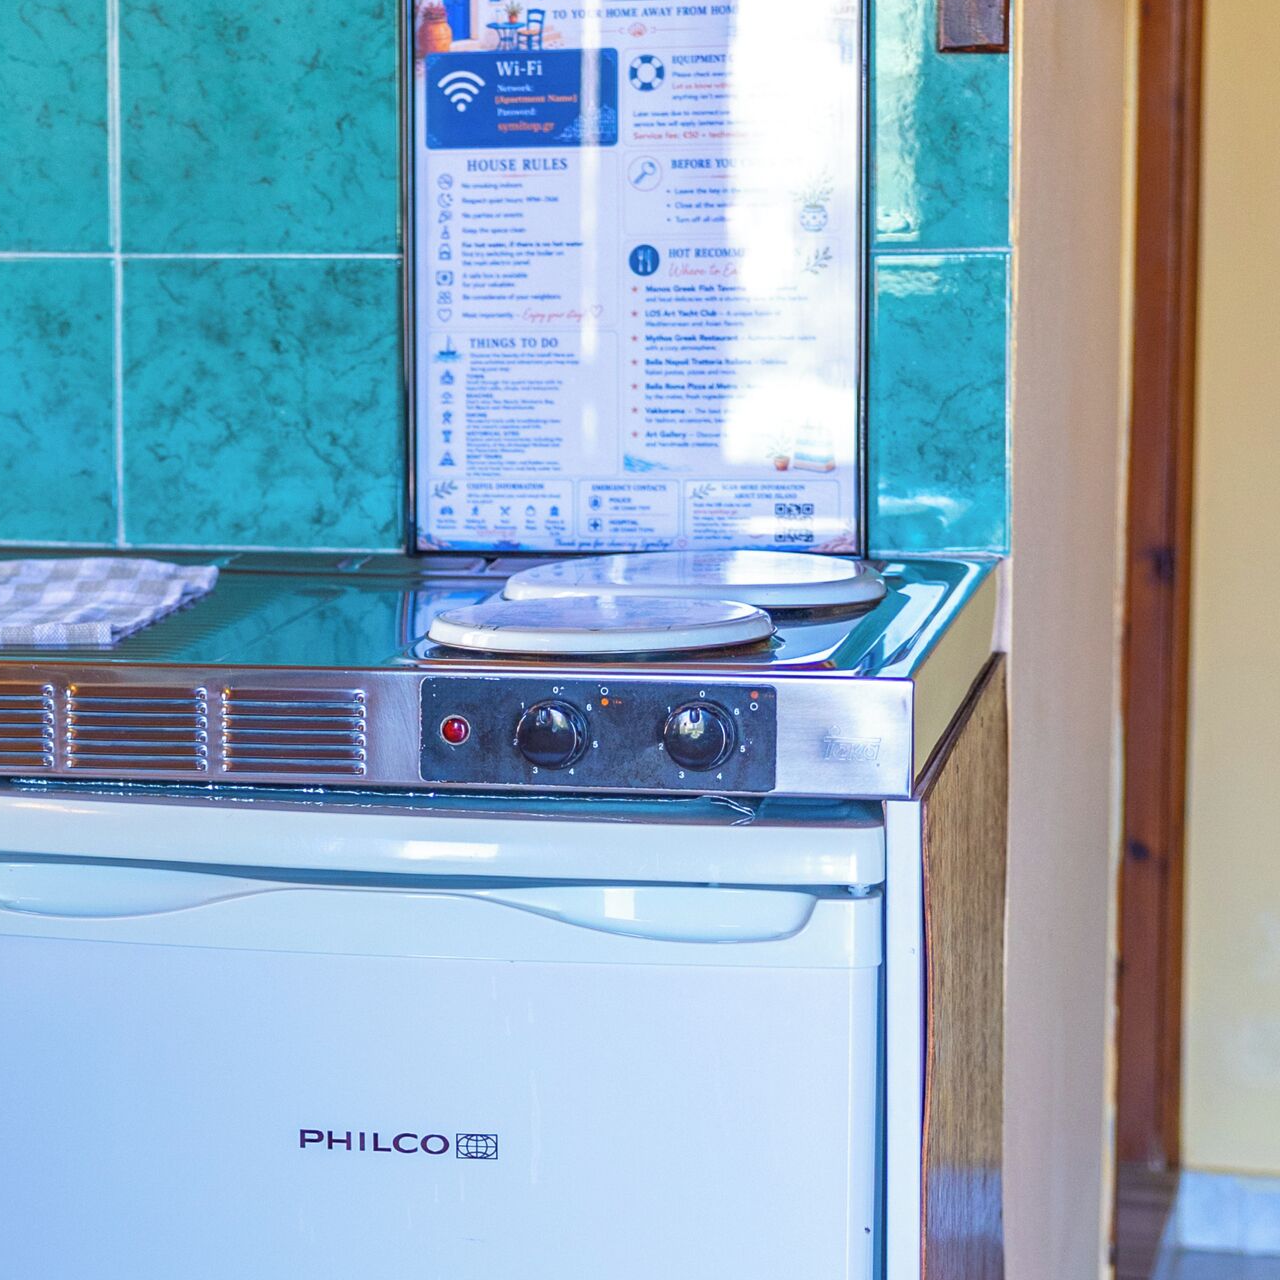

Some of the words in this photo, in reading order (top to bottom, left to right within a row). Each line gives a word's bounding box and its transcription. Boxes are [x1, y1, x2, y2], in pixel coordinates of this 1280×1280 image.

[552, 10, 568, 20] TO
[606, 8, 638, 18] HOME
[641, 7, 673, 17] AWAY
[676, 6, 709, 17] FROM
[711, 6, 738, 16] HOM
[672, 54, 727, 65] EQUIPMENT
[496, 60, 542, 76] Wi-Fi
[467, 159, 516, 172] HOUSE
[522, 158, 568, 171] RULES
[671, 158, 710, 169] BEFORE
[669, 248, 690, 258] HOT
[668, 263, 705, 277] Where
[470, 338, 516, 348] THINGS
[521, 338, 537, 347] TO
[541, 338, 558, 347] DO
[646, 335, 673, 343] Mythos
[552, 686, 559, 694] 0
[699, 690, 706, 698] 0
[734, 708, 740, 716] 6
[658, 743, 664, 751] 2
[740, 745, 746, 753] 5
[716, 772, 722, 780] 4
[299, 1128, 450, 1155] PHILCO
